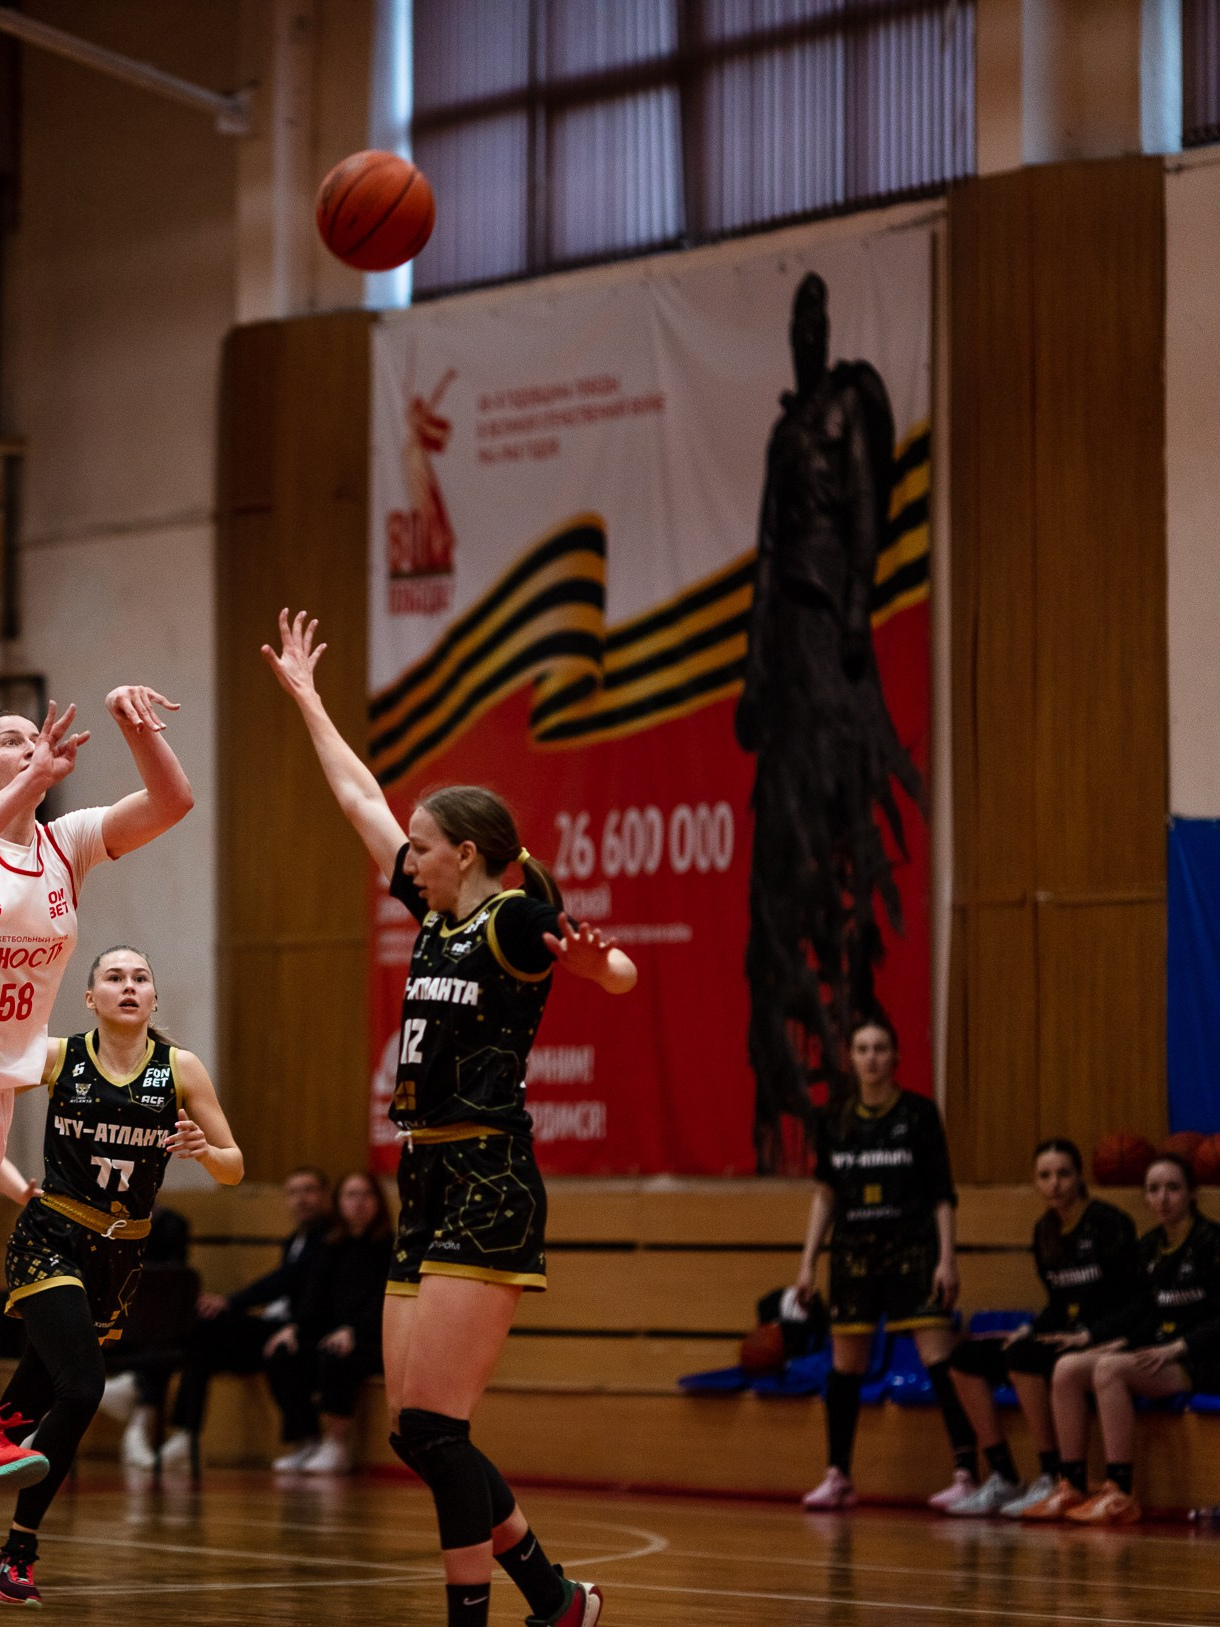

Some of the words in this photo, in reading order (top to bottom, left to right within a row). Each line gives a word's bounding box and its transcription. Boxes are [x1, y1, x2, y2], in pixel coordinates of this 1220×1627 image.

[554, 809, 596, 880] 26
[600, 802, 665, 878] 600
[668, 800, 735, 876] 000
[400, 1018, 427, 1065] 12
[142, 1077, 169, 1088] BET
[144, 1066, 171, 1079] FON
[54, 1115, 170, 1149] ЧГУ-АТЛАНТА
[90, 1154, 135, 1192] 77
